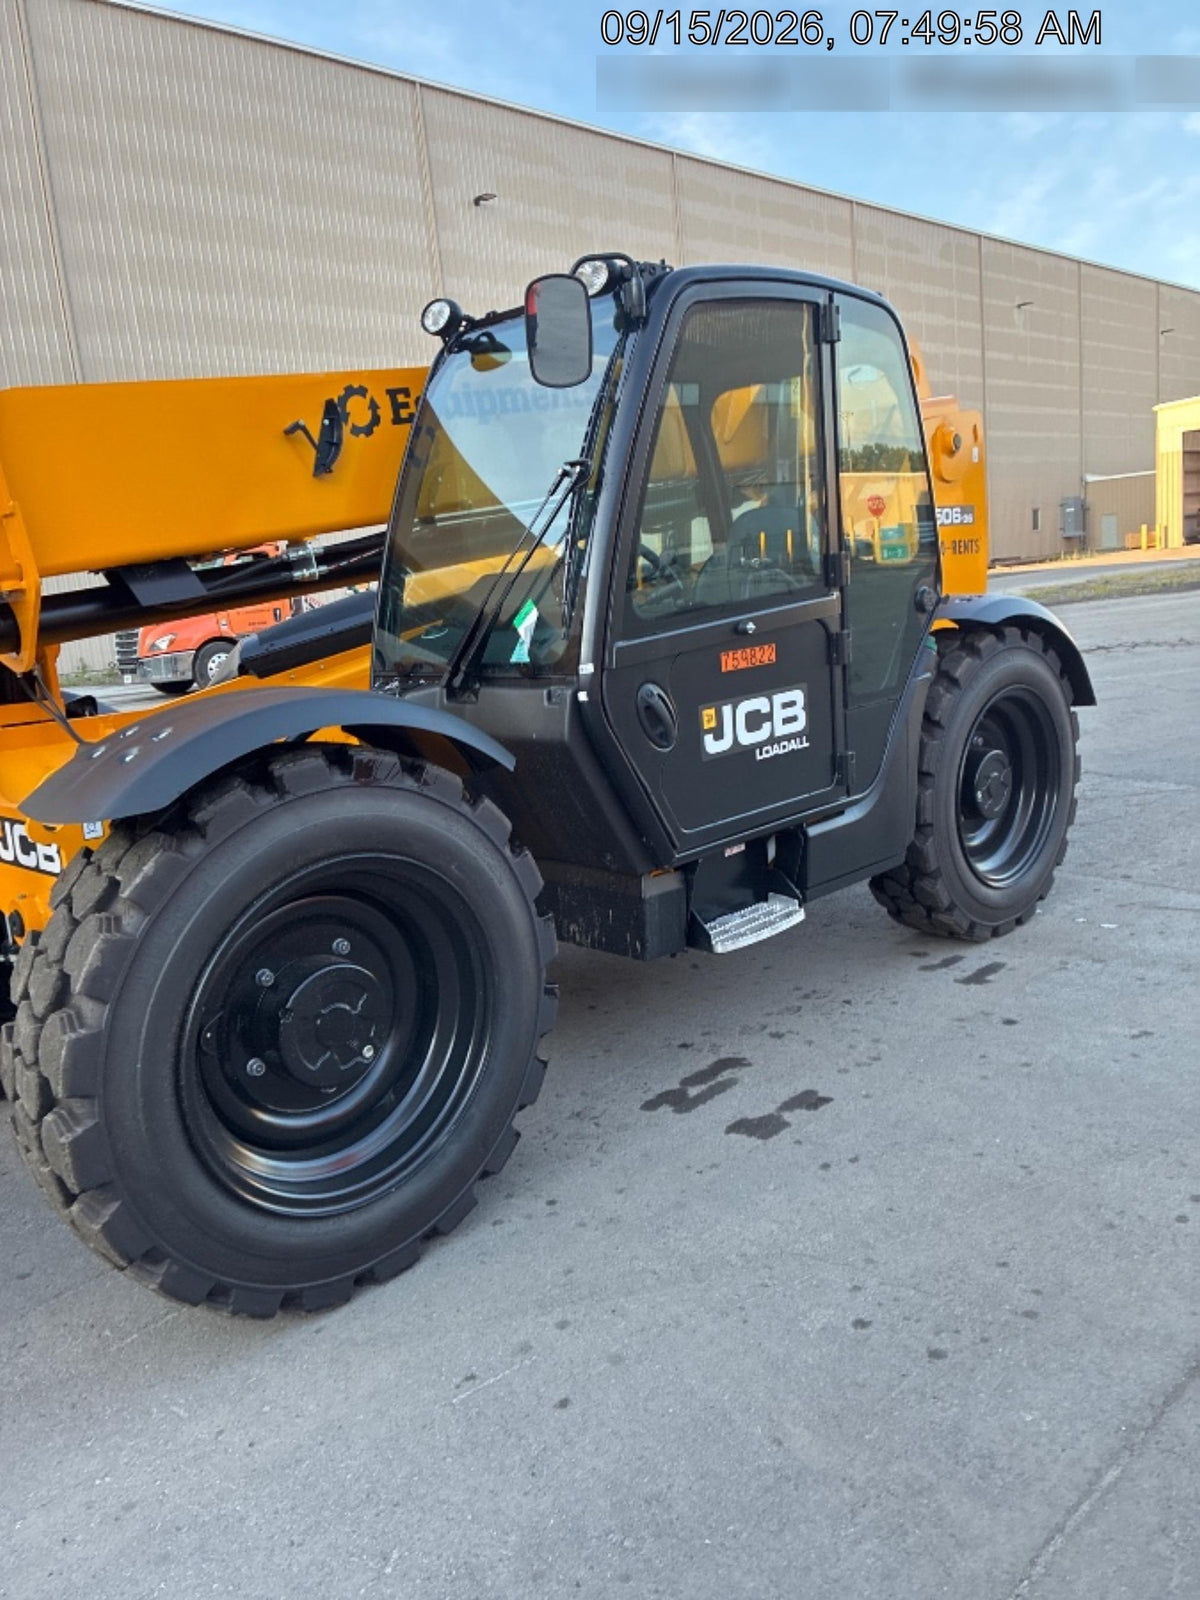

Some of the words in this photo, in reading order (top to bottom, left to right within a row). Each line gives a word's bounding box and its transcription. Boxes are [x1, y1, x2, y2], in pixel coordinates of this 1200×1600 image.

[704, 689, 806, 754] JCB
[755, 736, 810, 760] LOADALL
[0, 820, 61, 874] JCB
